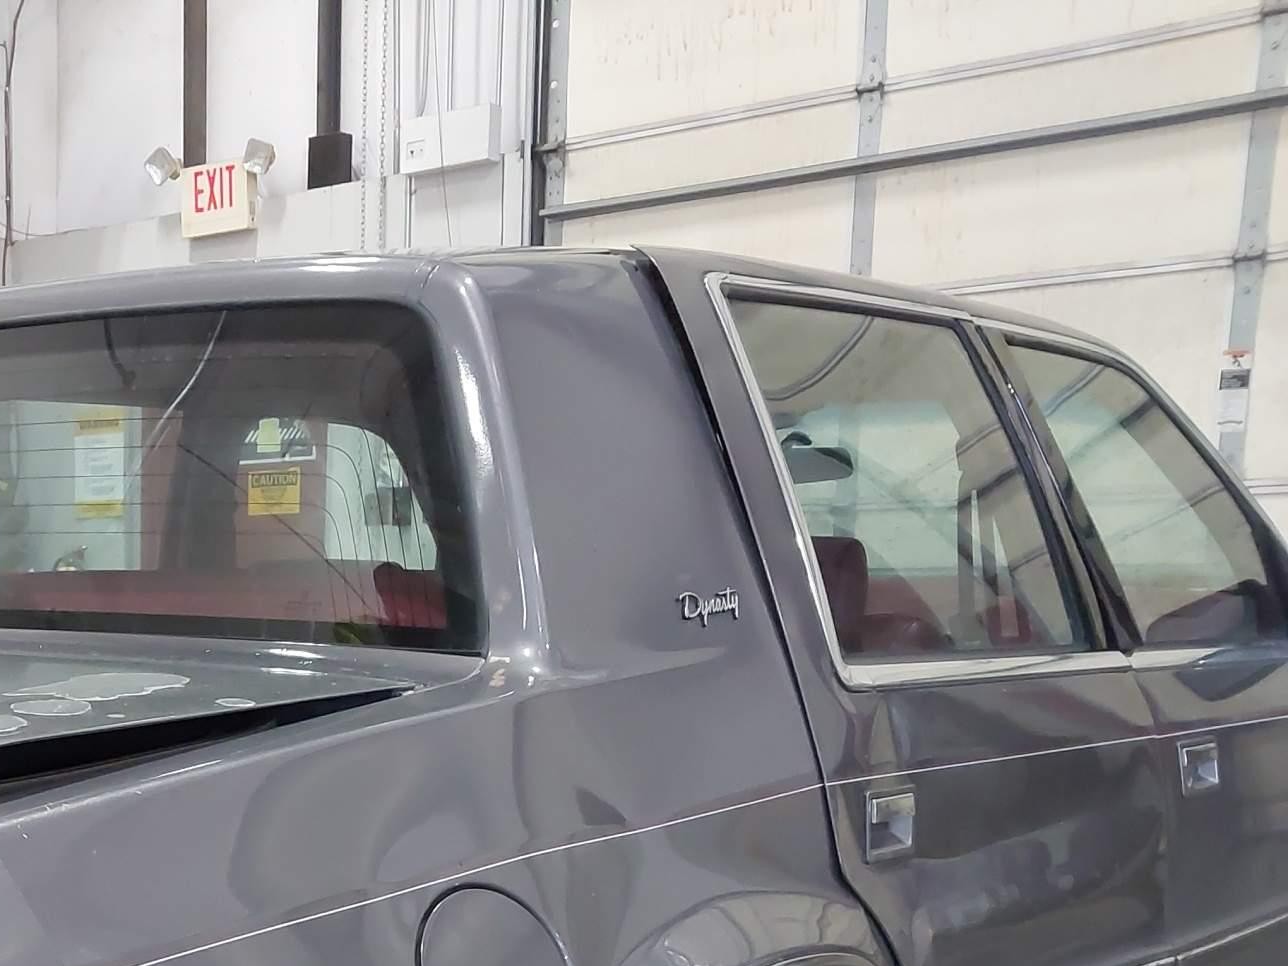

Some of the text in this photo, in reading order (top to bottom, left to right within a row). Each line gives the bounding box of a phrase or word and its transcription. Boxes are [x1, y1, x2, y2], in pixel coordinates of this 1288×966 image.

[193, 164, 236, 213] EXIT
[252, 472, 297, 487] CAUTION
[679, 586, 739, 626] Dynasty
